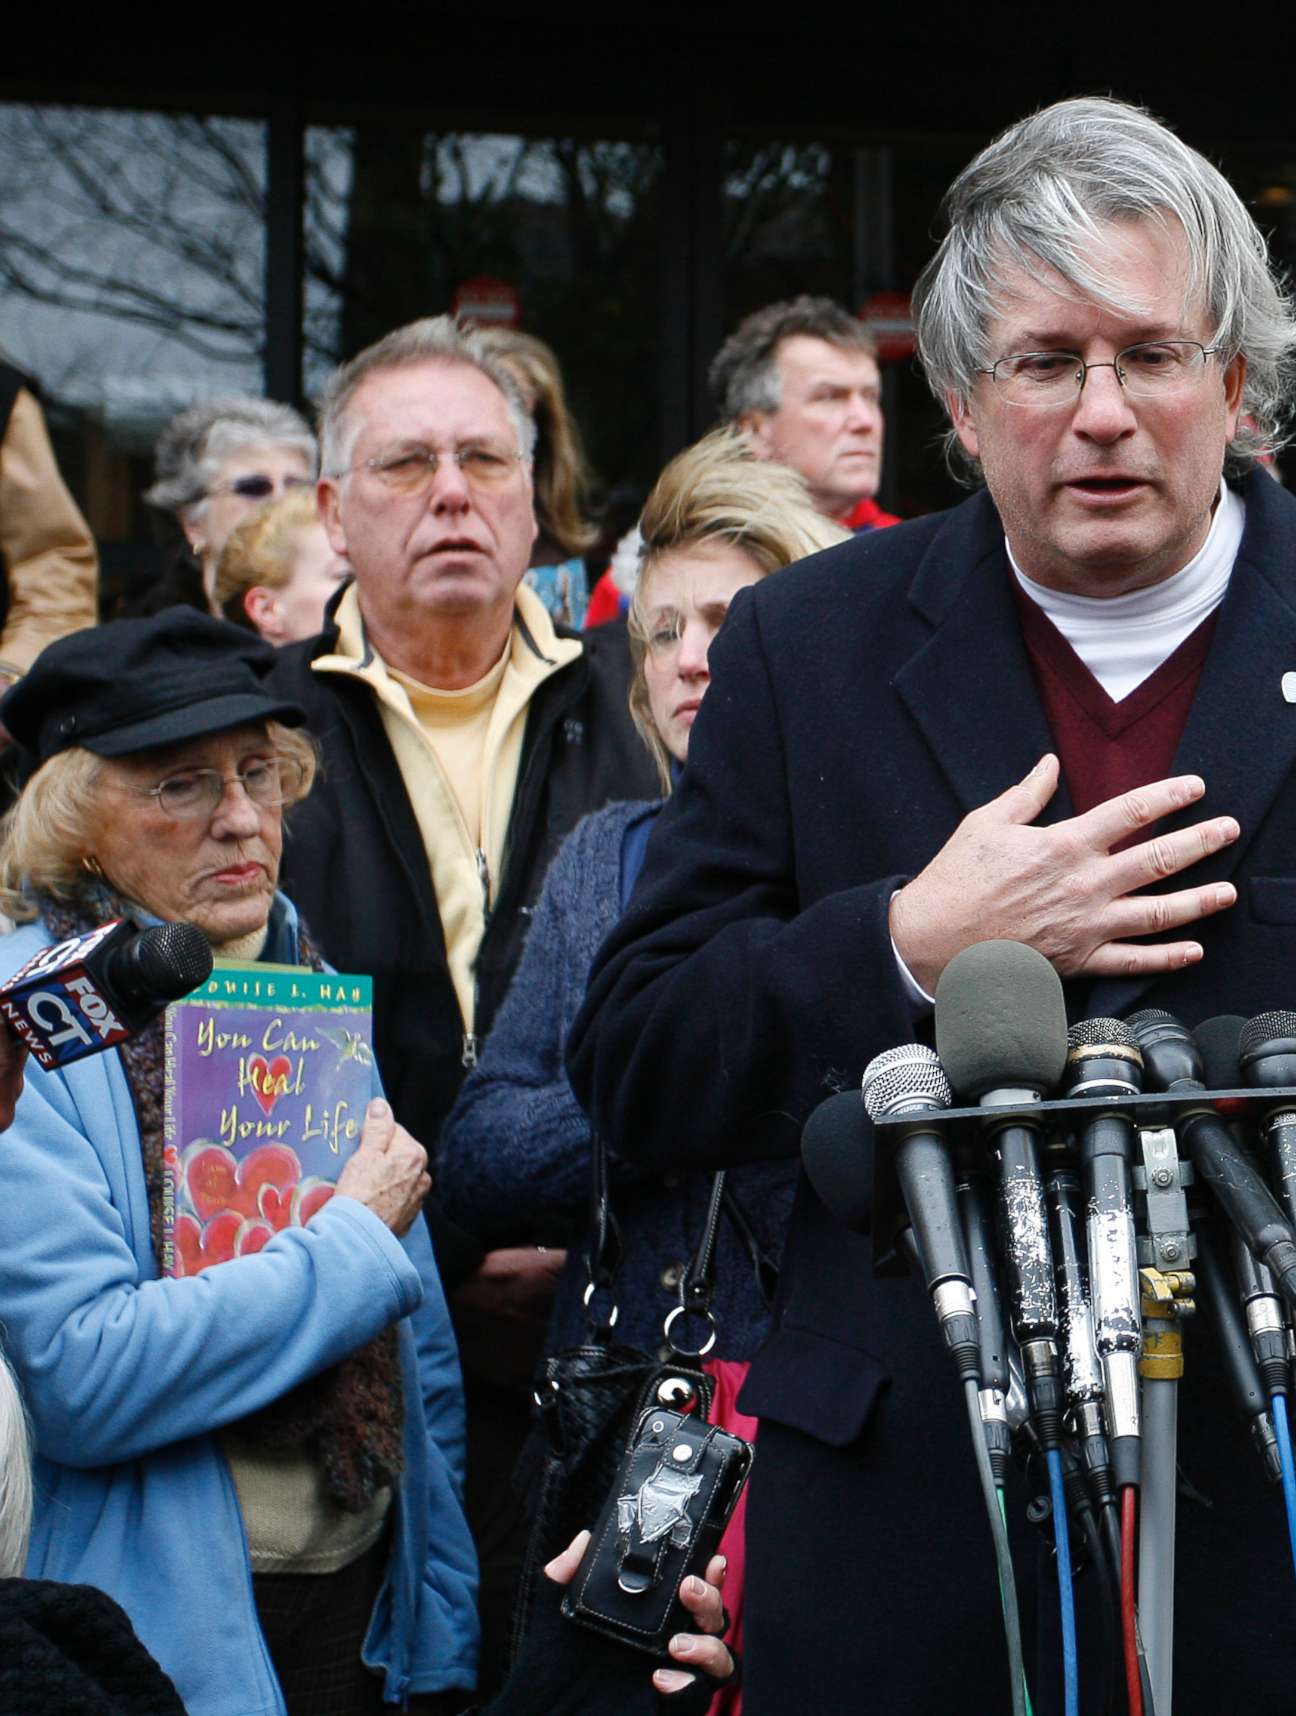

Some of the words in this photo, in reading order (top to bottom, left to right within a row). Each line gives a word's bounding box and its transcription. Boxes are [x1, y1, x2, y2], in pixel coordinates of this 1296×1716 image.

[65, 976, 125, 1038] FOX
[193, 980, 276, 997] OUISE
[2, 1002, 53, 1063] NEWS
[27, 991, 93, 1046] CT
[197, 1017, 252, 1056] You
[262, 1018, 320, 1051] Can
[237, 1057, 305, 1096] Heal
[220, 1104, 291, 1147] Your
[302, 1100, 358, 1154] Life
